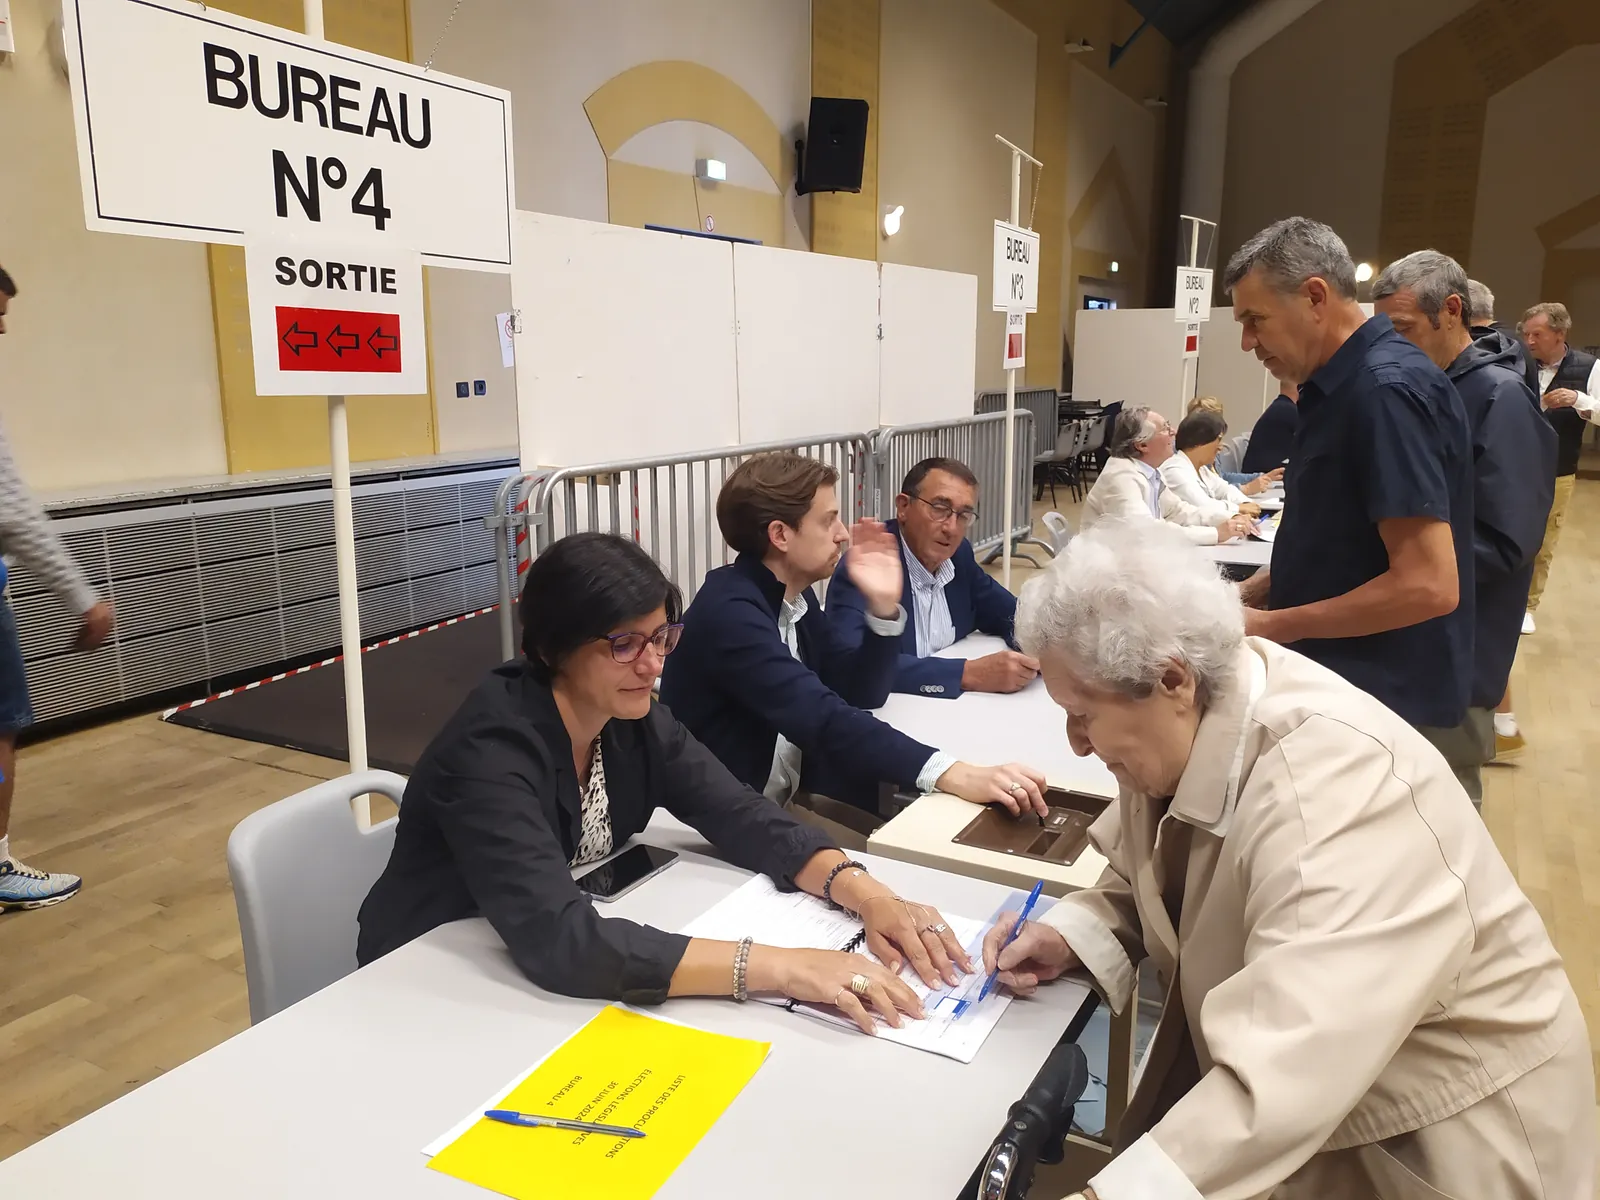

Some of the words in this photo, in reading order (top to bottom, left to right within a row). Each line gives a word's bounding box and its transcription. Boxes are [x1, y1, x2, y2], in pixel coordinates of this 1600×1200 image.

[202, 41, 433, 149] BUREAU
[1006, 237, 1030, 264] BUREAU
[274, 256, 397, 295] SORTIE
[1186, 275, 1205, 290] BUREAU
[552, 1075, 583, 1101] BUREAU
[607, 1080, 619, 1090] 30
[616, 1068, 653, 1101] ÉLECTIONS
[667, 1074, 686, 1092] LISTE
[592, 1089, 610, 1104] JUIN
[655, 1091, 671, 1105] DES
[575, 1103, 595, 1121] 2024
[605, 1105, 659, 1158] PROCUTIONS
